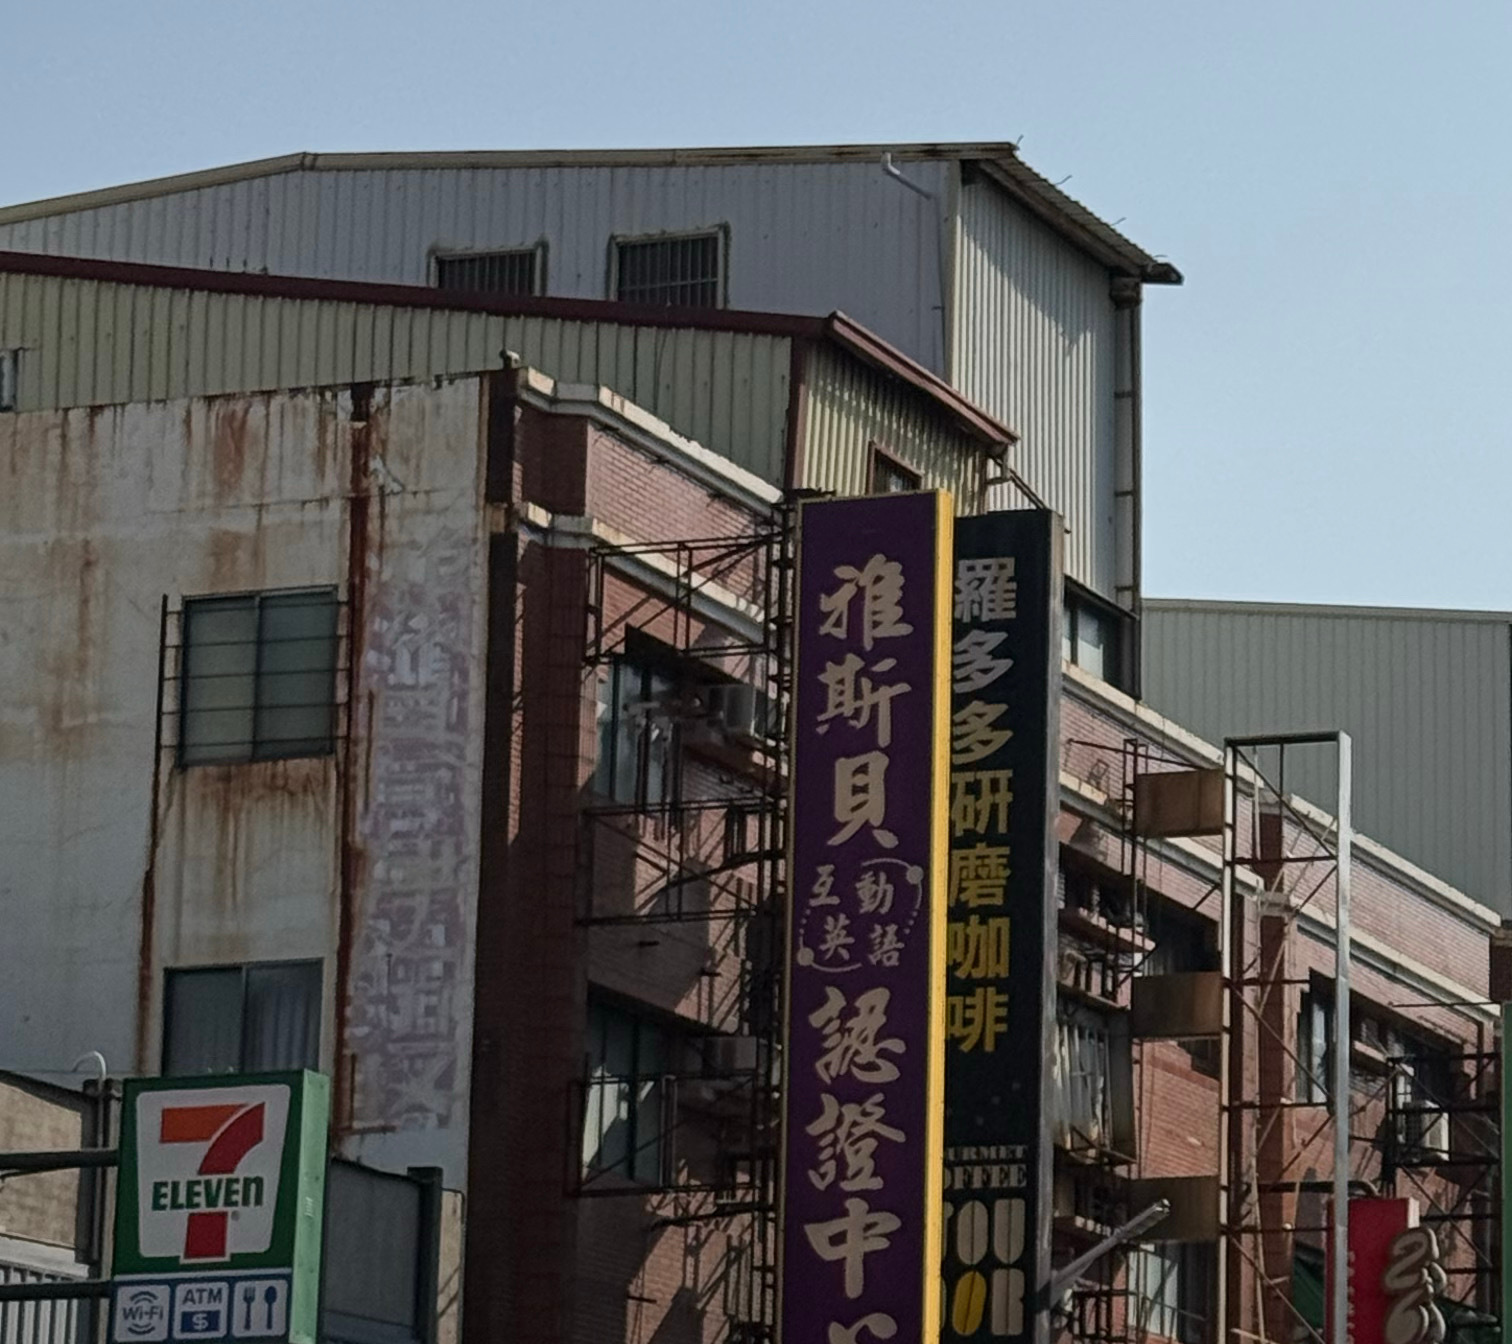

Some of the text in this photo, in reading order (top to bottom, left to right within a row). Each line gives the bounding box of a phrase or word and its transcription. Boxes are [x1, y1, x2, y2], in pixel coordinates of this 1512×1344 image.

[817, 553, 914, 850] 雅斯貝
[944, 556, 1017, 1053] 羅多多研磨咖啡
[945, 1144, 1028, 1161] URMET
[182, 1287, 223, 1306] ATM
[122, 1307, 164, 1322] Wi-Fi
